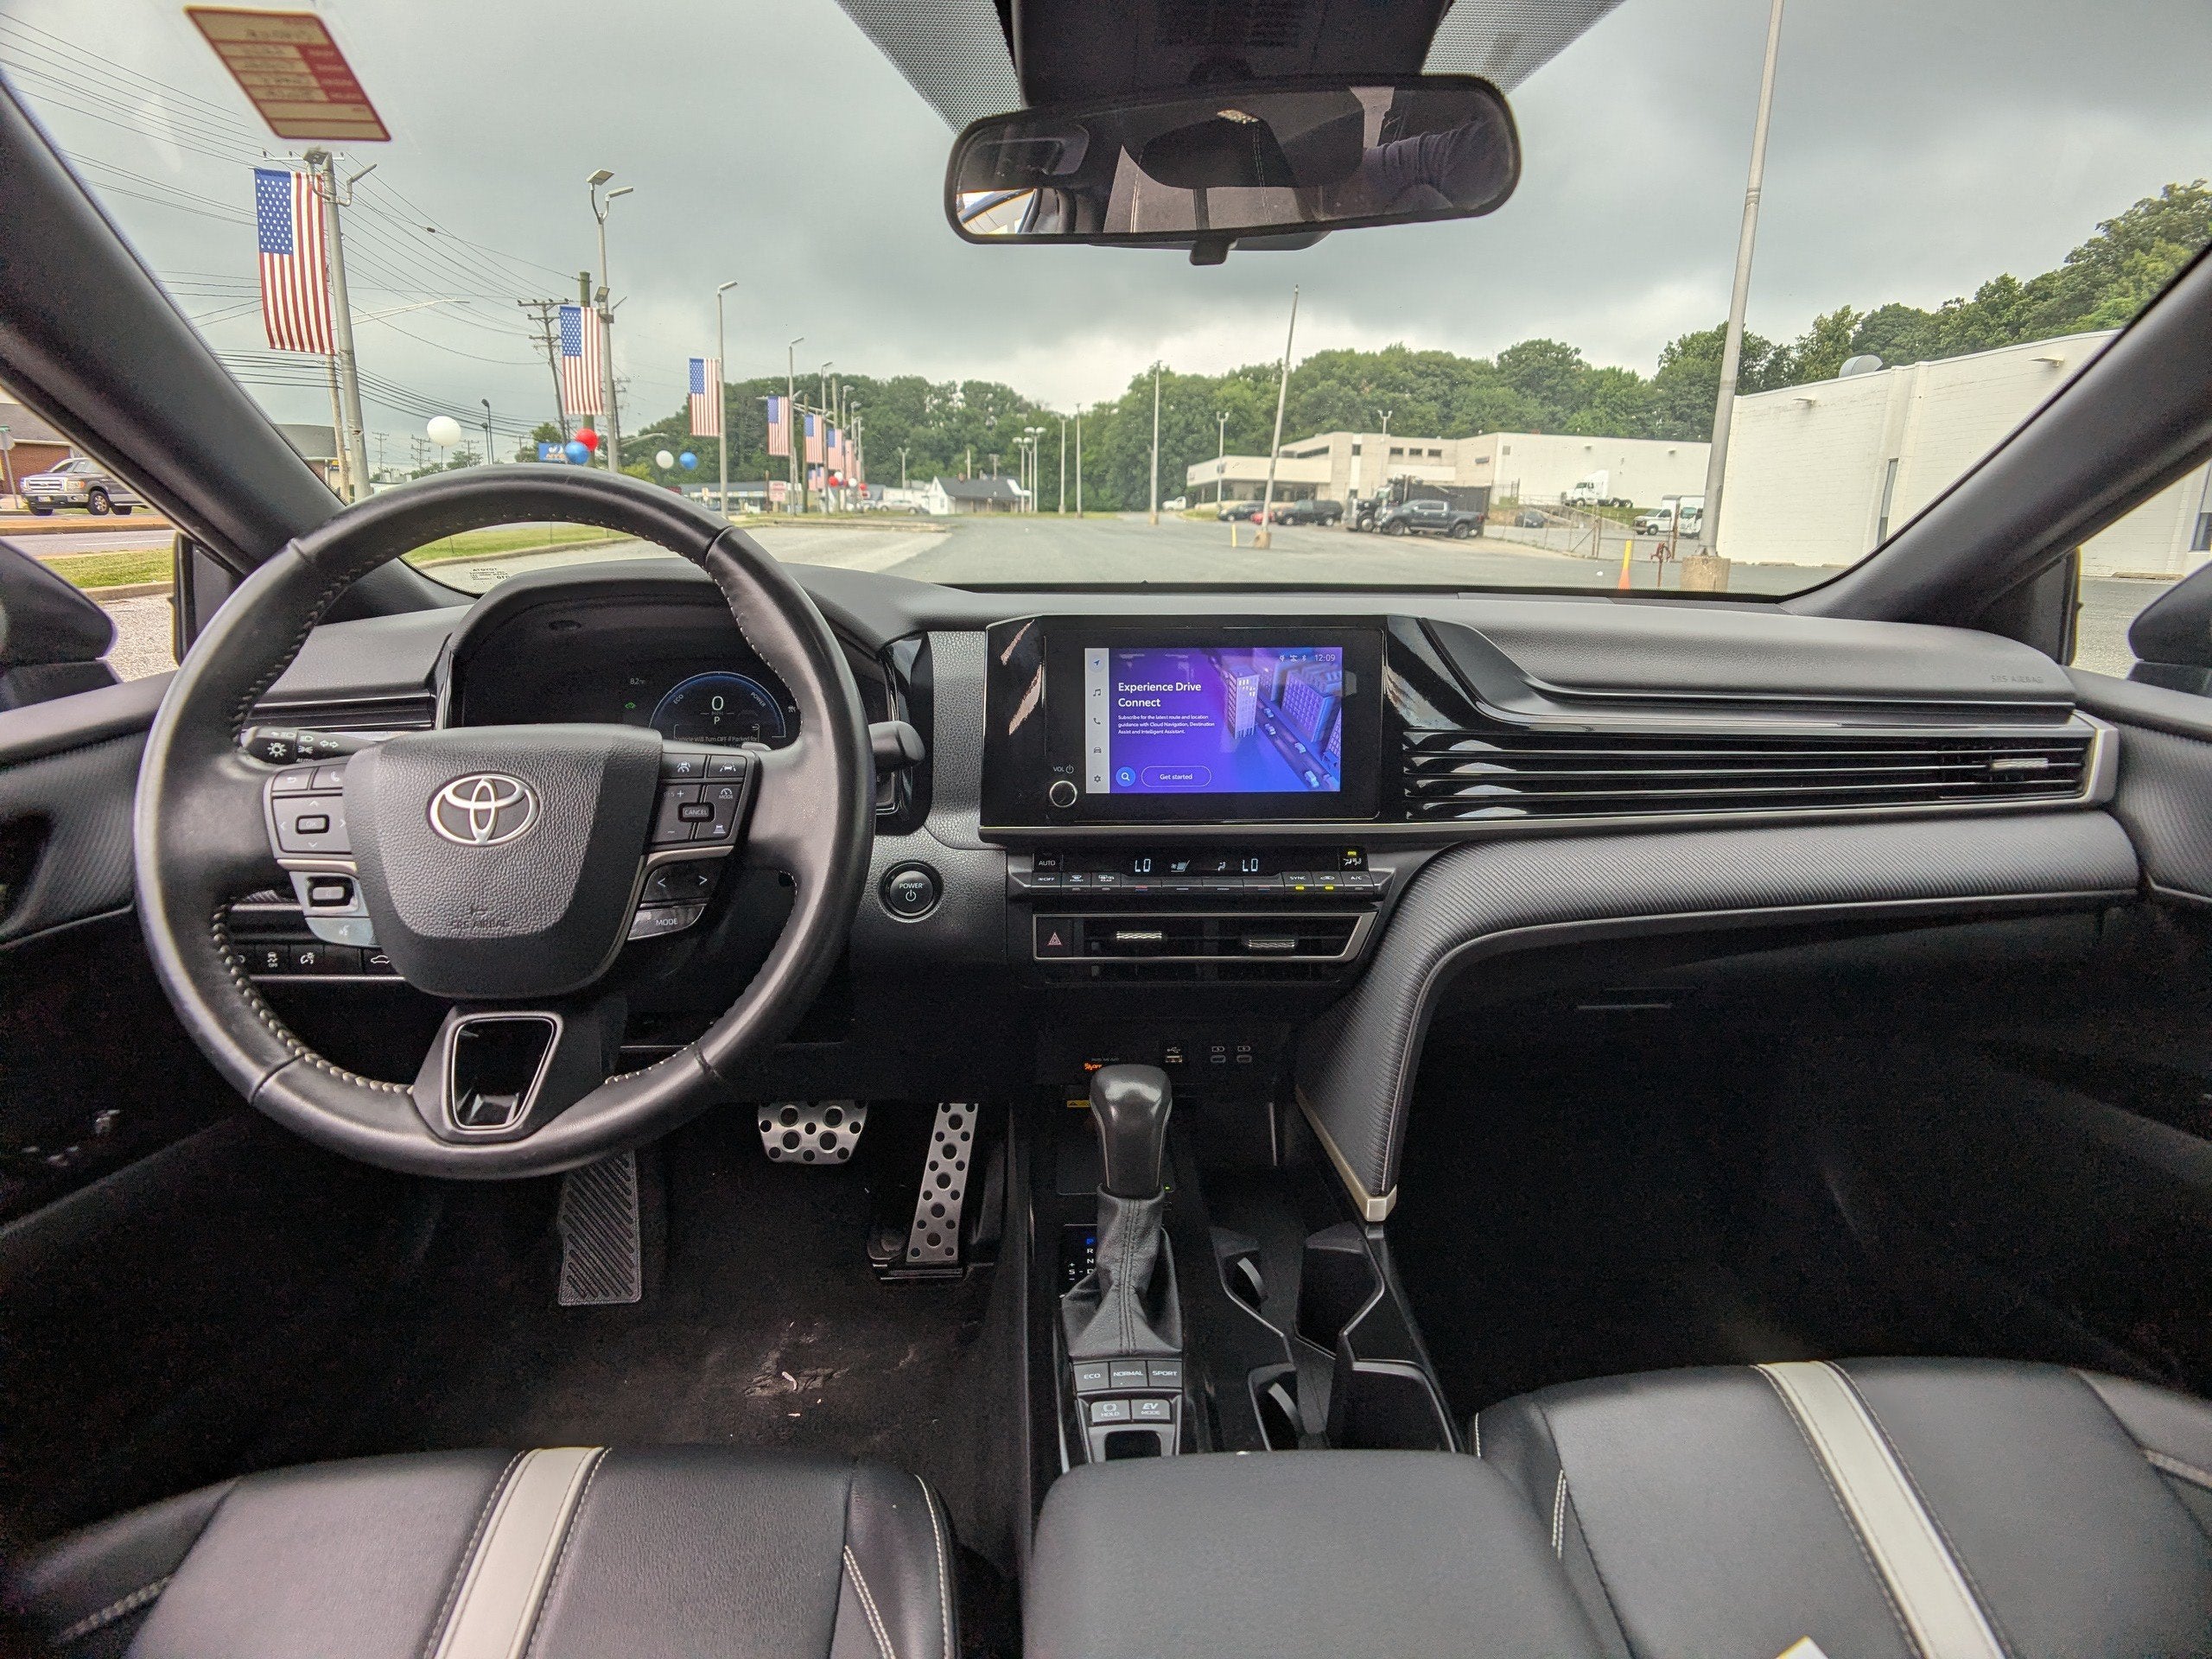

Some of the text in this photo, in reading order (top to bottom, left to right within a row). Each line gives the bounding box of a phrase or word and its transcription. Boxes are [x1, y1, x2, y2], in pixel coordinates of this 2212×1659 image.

[1118, 682, 1202, 693] Experience Drive
[673, 694, 684, 705] ECO
[711, 696, 724, 710] 0
[750, 691, 766, 707] POWER
[1118, 698, 1161, 707] Connect
[714, 716, 721, 725] P
[1135, 858, 1151, 872] LO
[1242, 858, 1259, 872] LO
